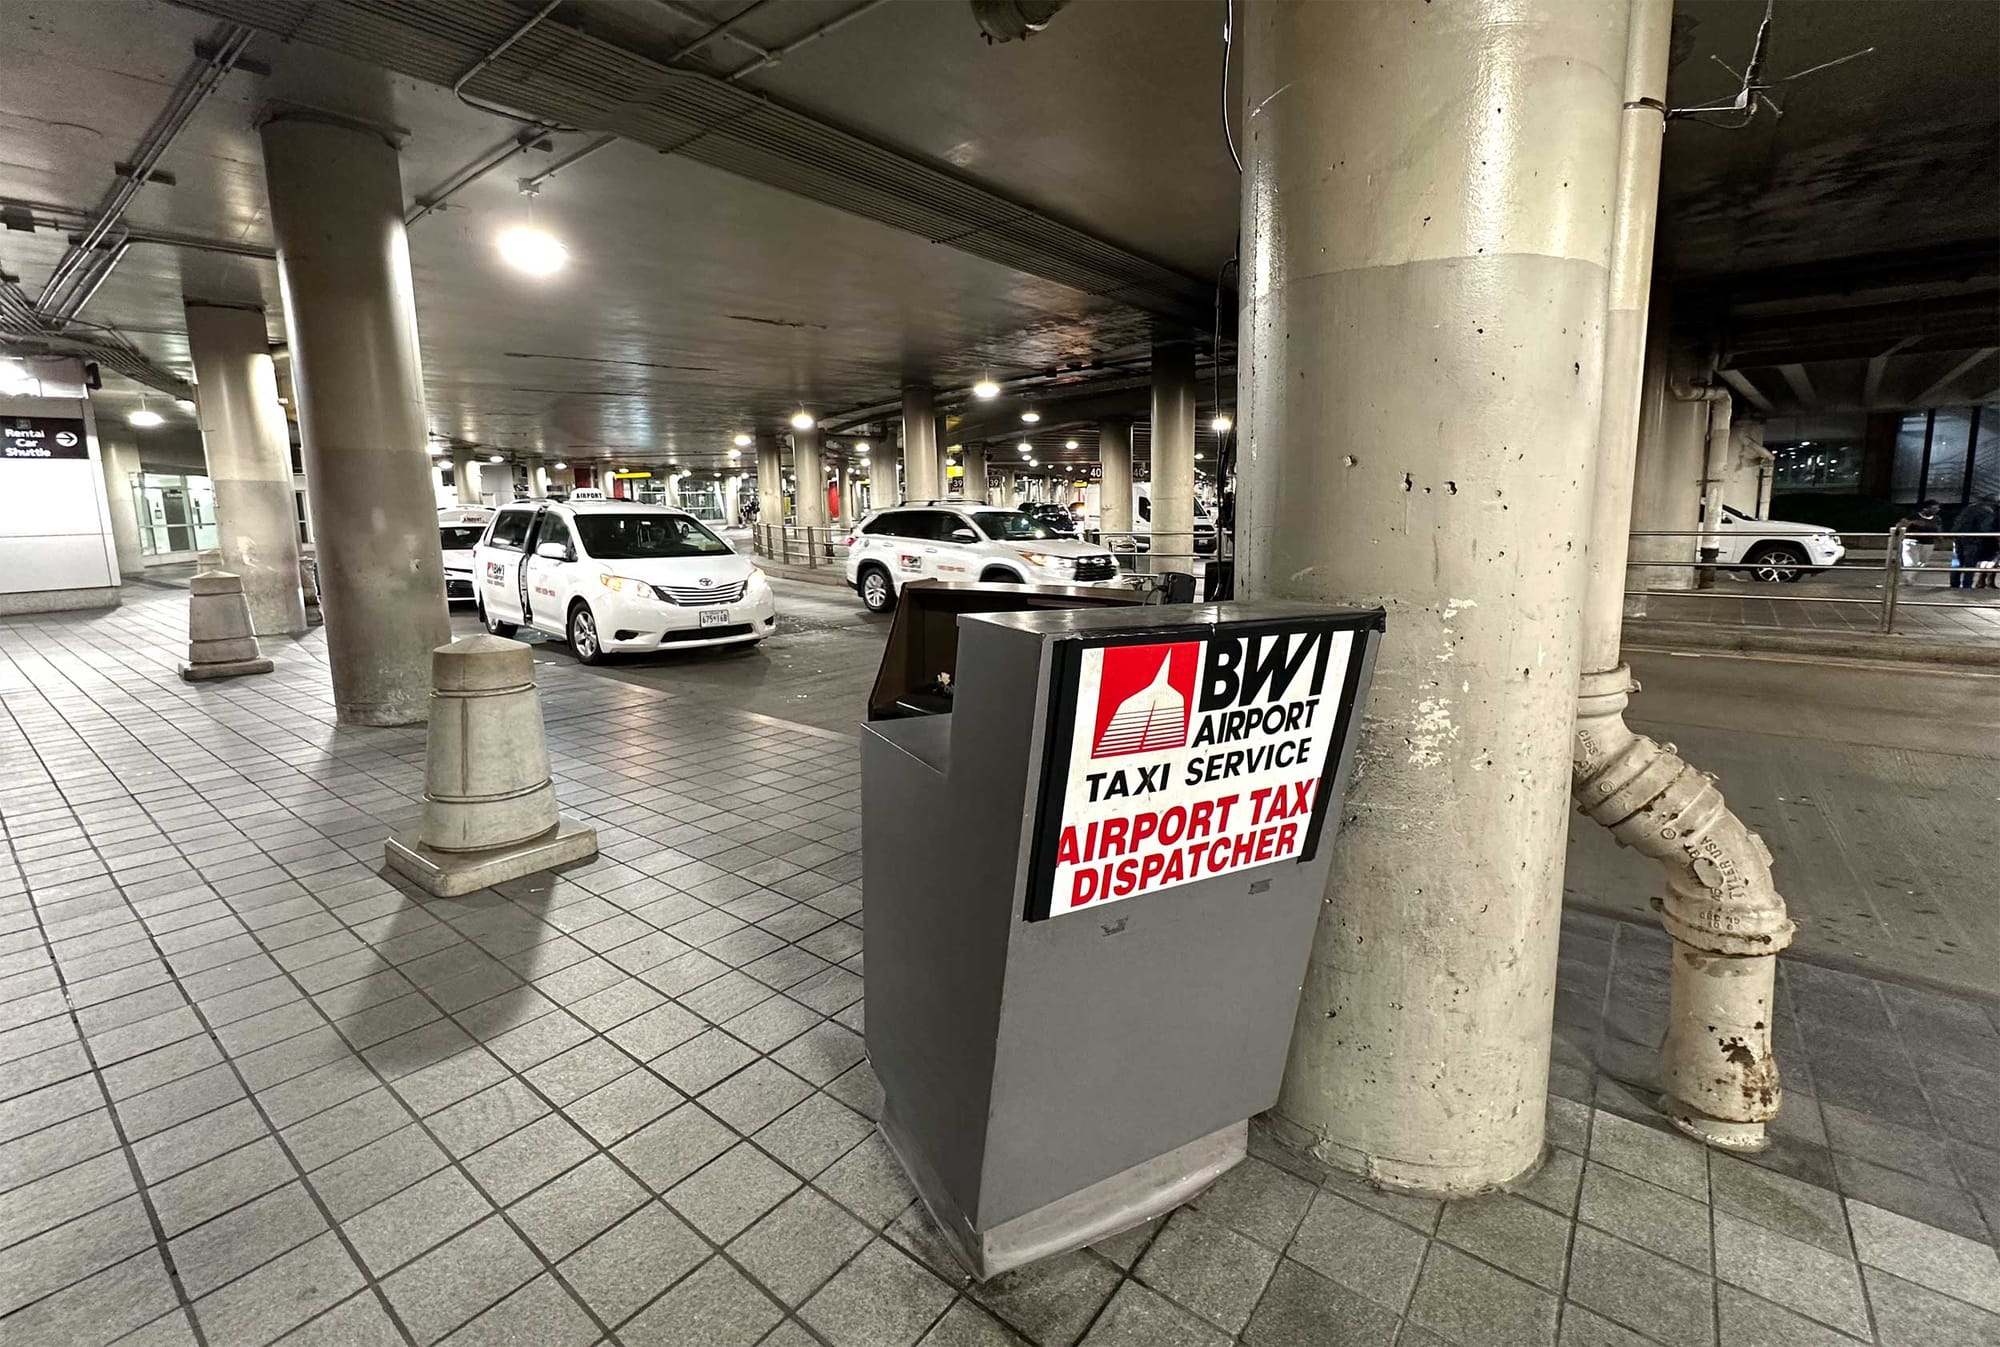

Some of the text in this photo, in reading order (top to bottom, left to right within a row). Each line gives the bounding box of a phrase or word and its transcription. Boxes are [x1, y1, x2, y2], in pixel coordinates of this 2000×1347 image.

[5, 429, 45, 438] Rental
[15, 438, 38, 447] Car
[5, 447, 52, 457] Shuttle
[1090, 467, 1102, 478] 40
[1133, 467, 1145, 477] 40
[953, 479, 963, 488] 39
[989, 479, 999, 487] 39
[1199, 631, 1333, 712] BWI
[1192, 699, 1319, 748] AIRPORT
[1086, 737, 1312, 802] TAXI SERVICE
[1056, 794, 1239, 868] AIRPORT
[1701, 836, 1722, 859] USA
[1070, 822, 1298, 908] DISPATCHER
